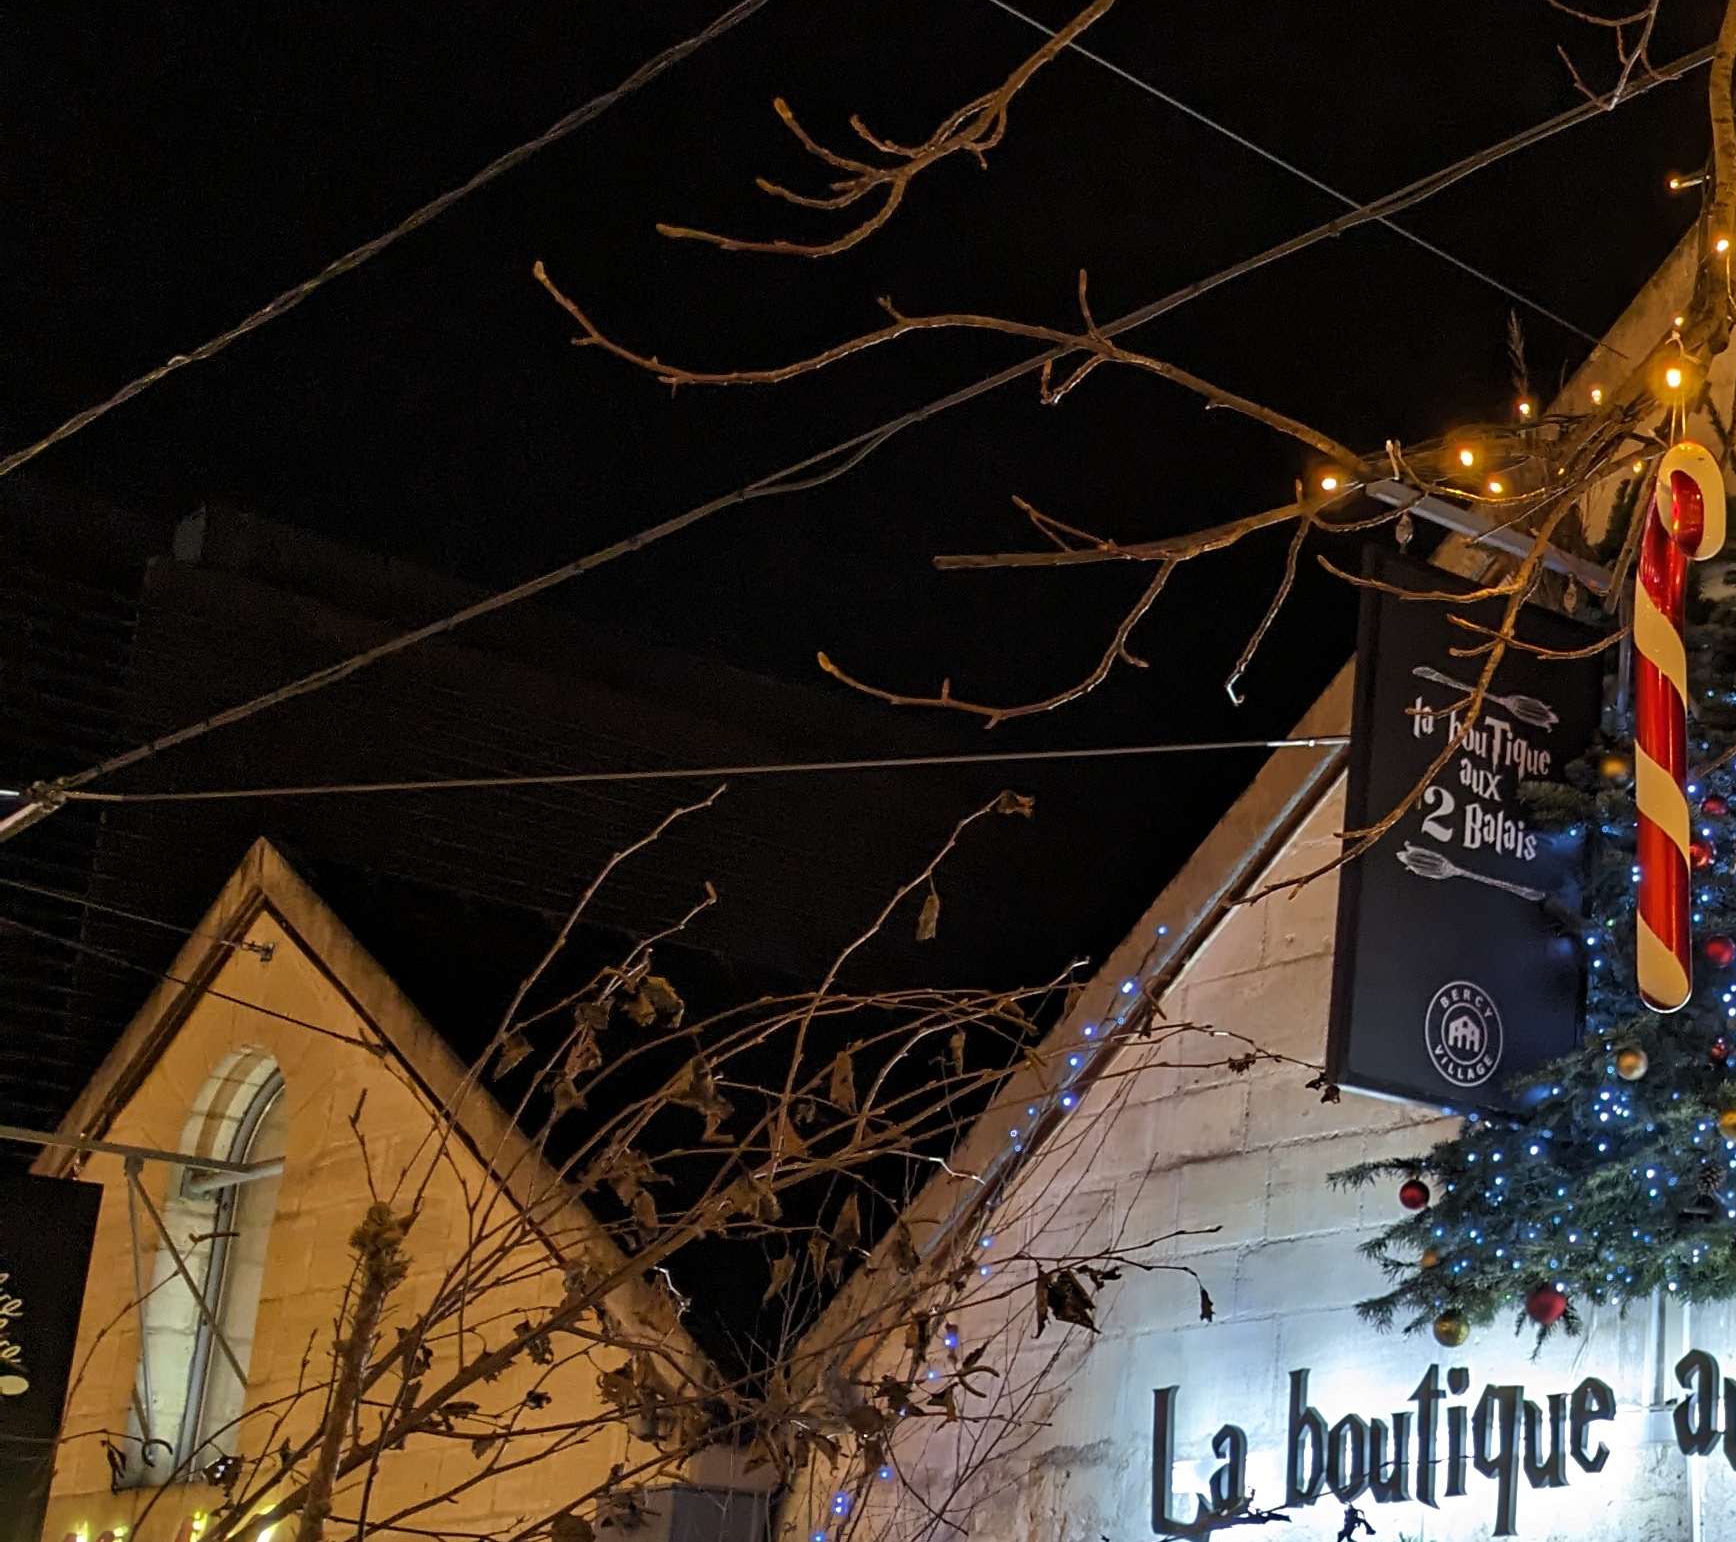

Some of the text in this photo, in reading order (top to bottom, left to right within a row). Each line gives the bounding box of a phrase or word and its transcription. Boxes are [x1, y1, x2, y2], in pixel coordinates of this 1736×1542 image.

[1459, 758, 1502, 802] aux
[1421, 785, 1537, 861] 2 Balais
[1440, 988, 1493, 1018] BERCY
[1434, 1044, 1493, 1080] VILLAGE
[1286, 1364, 1616, 1536] boutique
